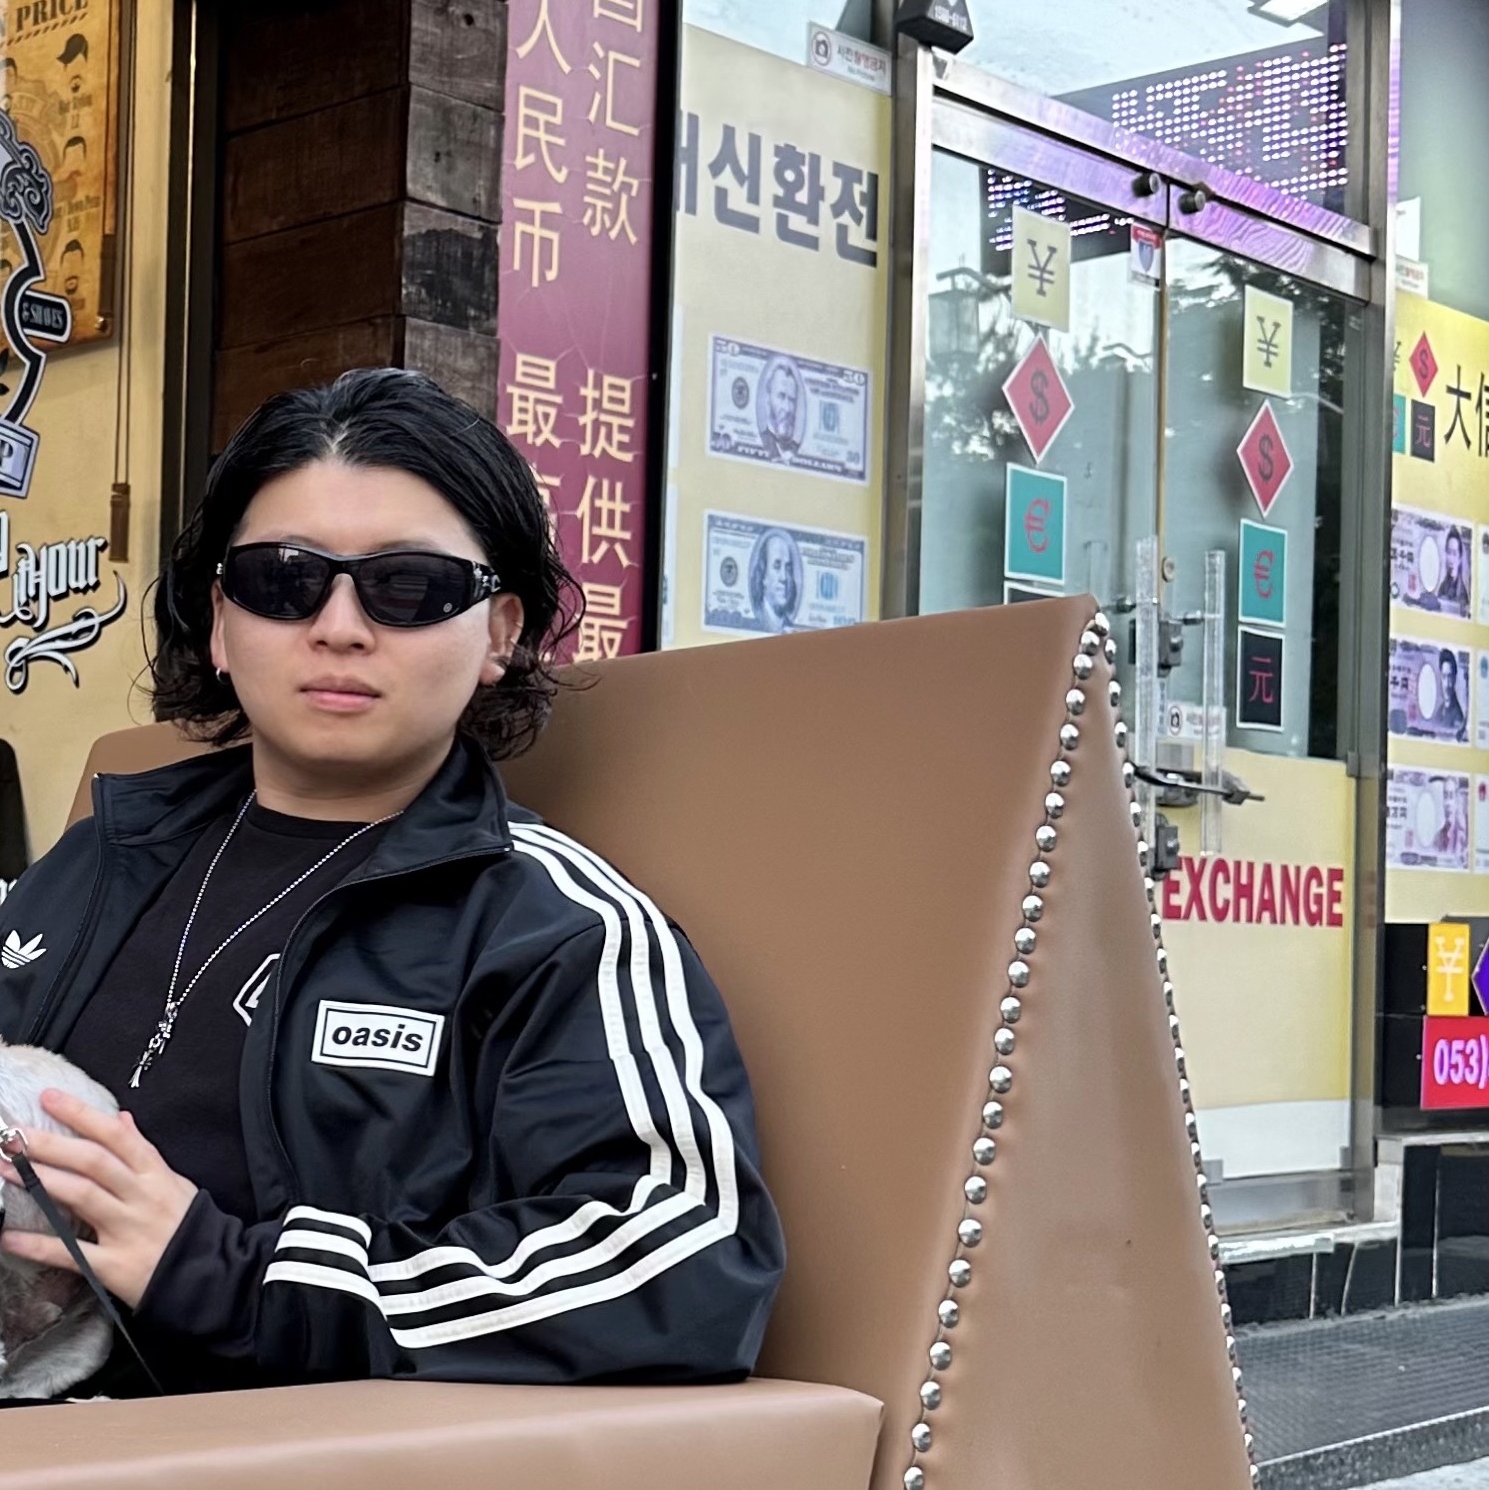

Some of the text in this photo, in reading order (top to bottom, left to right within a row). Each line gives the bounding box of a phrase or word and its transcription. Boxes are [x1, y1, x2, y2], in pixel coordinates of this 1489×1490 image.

[511, 0, 572, 287] 人民币
[1415, 415, 1431, 449] 元
[1249, 656, 1274, 704] 元
[1163, 856, 1344, 928] EXCHANGE
[332, 1023, 424, 1053] oasis
[1433, 1034, 1489, 1090] 053)
